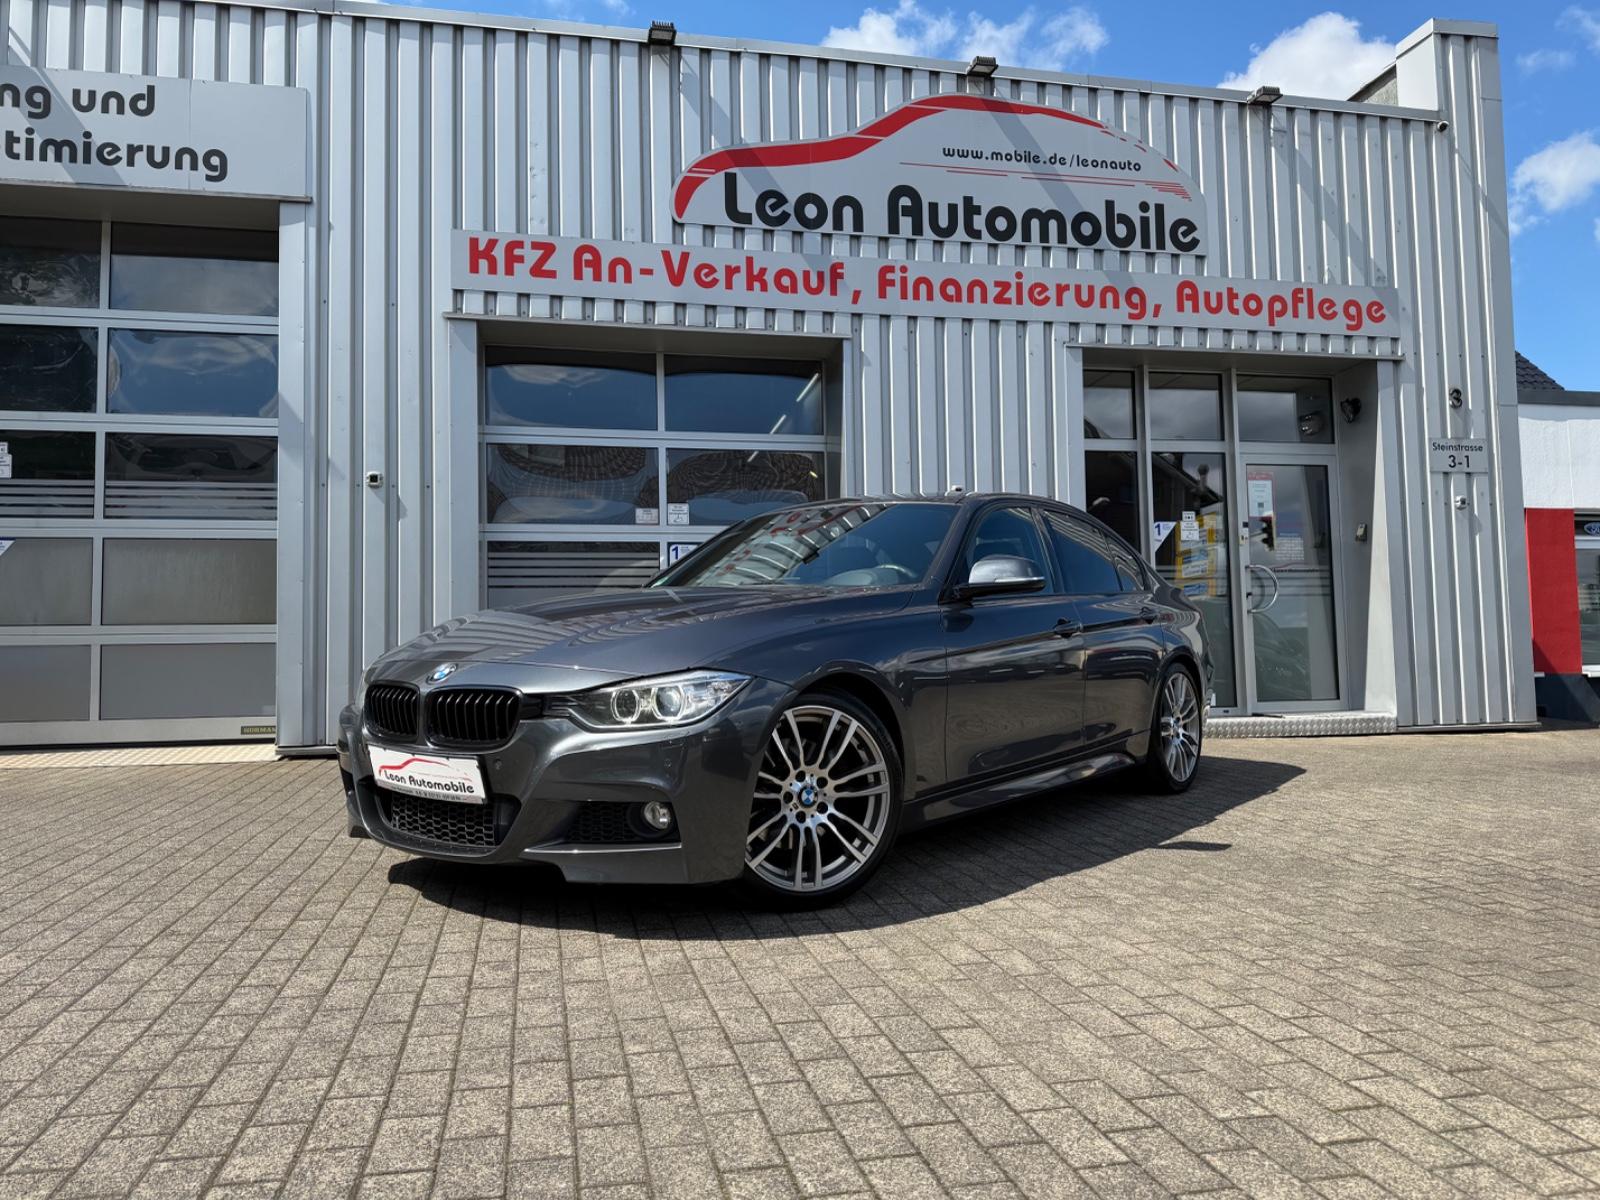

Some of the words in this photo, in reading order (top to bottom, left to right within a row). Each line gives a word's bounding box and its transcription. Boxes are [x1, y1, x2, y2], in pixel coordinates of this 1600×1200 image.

[73, 85, 155, 117] und
[942, 146, 1142, 173] www.mobile.de/leonauto
[724, 171, 864, 233] Leon
[887, 184, 1201, 253] Automobile
[469, 237, 557, 279] KFZ
[573, 244, 860, 305] An-Verkauf,
[878, 265, 1161, 321] Finanzierung,
[1176, 280, 1385, 331] Autopflege
[1449, 388, 1463, 409] 3
[1432, 441, 1484, 452] Steinstrasse
[1448, 454, 1470, 469] 3-1
[384, 769, 407, 784] Leon
[408, 775, 475, 794] Automobile
